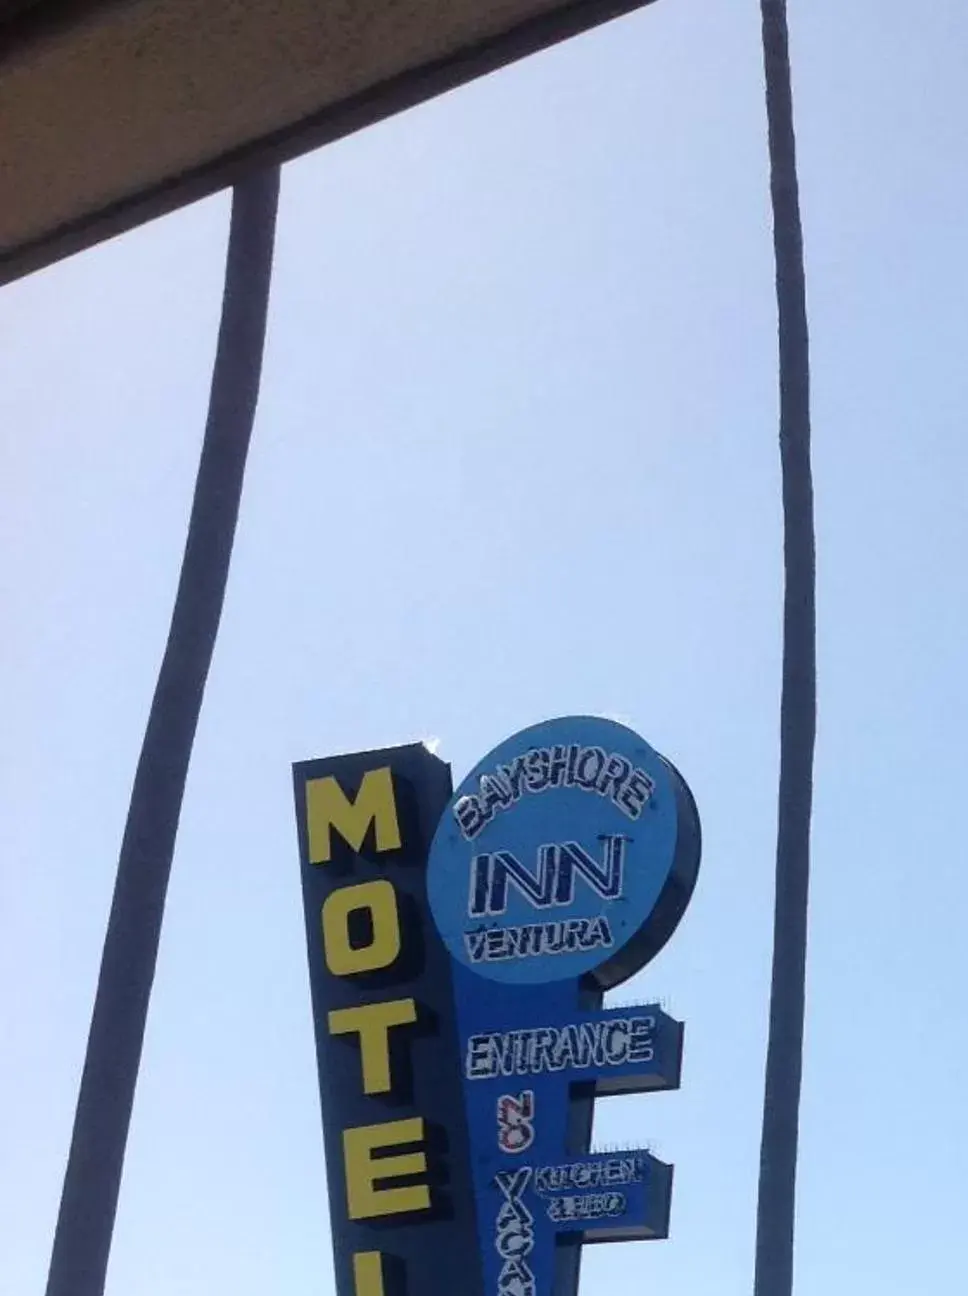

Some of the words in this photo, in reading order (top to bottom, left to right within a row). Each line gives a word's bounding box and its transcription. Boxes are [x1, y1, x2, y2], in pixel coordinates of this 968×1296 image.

[453, 744, 656, 841] BAYSHORE
[468, 834, 632, 918] INN
[463, 916, 614, 963] VENTURA
[467, 1017, 655, 1080] ENTRANCE
[497, 1090, 535, 1153] NO
[535, 1158, 643, 1192] KITCHEN
